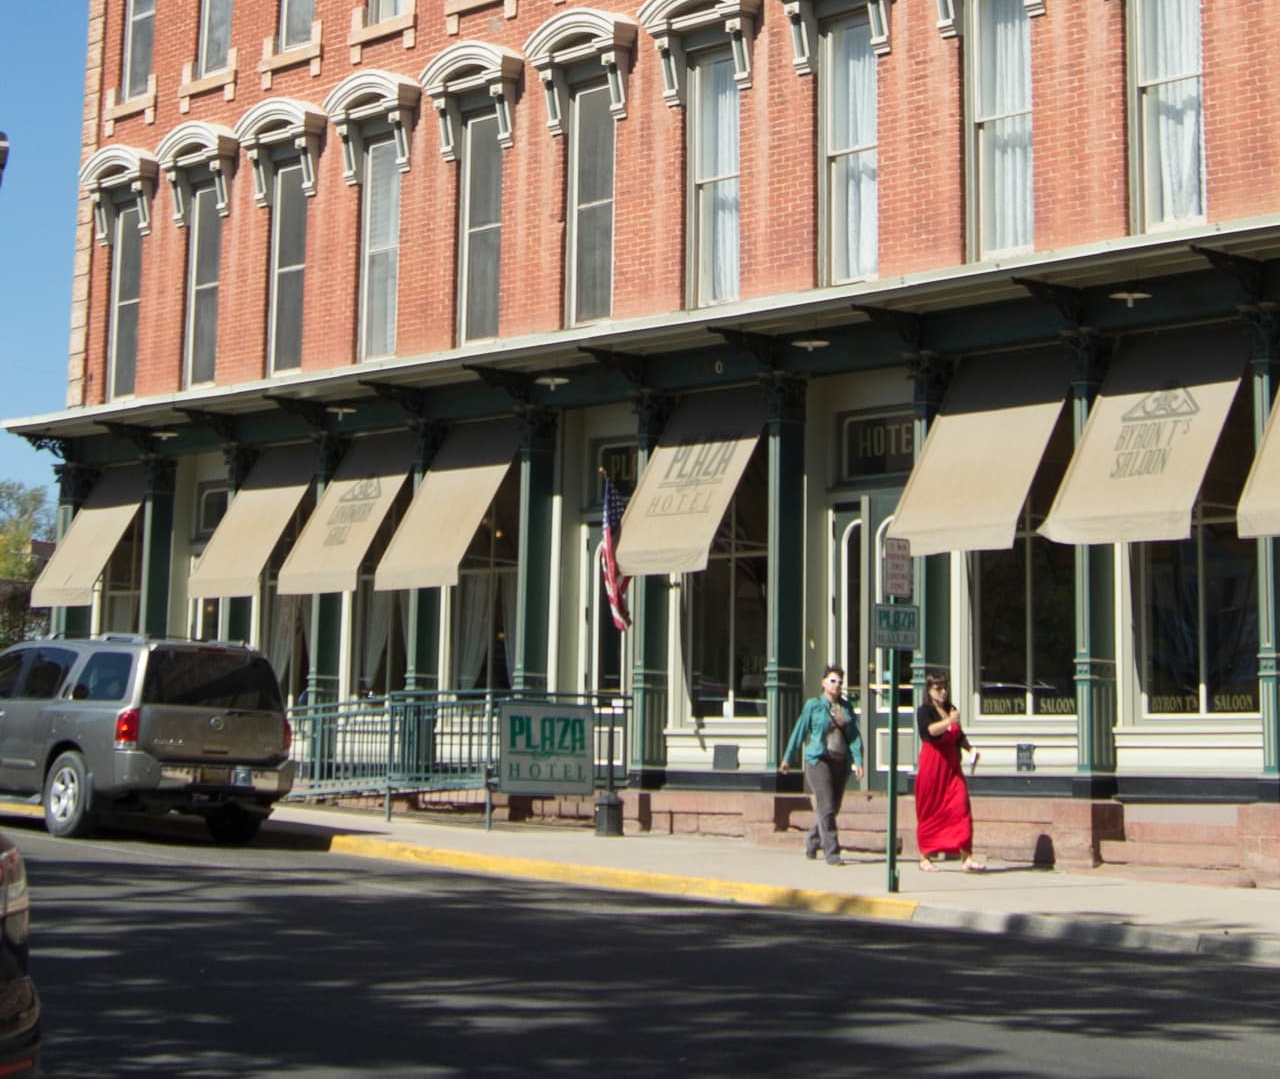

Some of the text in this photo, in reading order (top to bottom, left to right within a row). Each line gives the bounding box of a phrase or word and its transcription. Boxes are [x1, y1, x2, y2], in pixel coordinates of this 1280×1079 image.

[1114, 421, 1168, 451] BYRON
[663, 434, 739, 480] PLAZA
[1110, 447, 1173, 479] SALOON
[647, 491, 713, 514] HOTEL
[878, 608, 916, 631] PLAZA
[983, 697, 1012, 713] BYRON
[1040, 697, 1075, 713] SALOON
[1152, 695, 1183, 712] BYRON
[1214, 694, 1254, 711] SALOON
[509, 715, 586, 755] PLAZA
[509, 762, 587, 779] HOTEL
